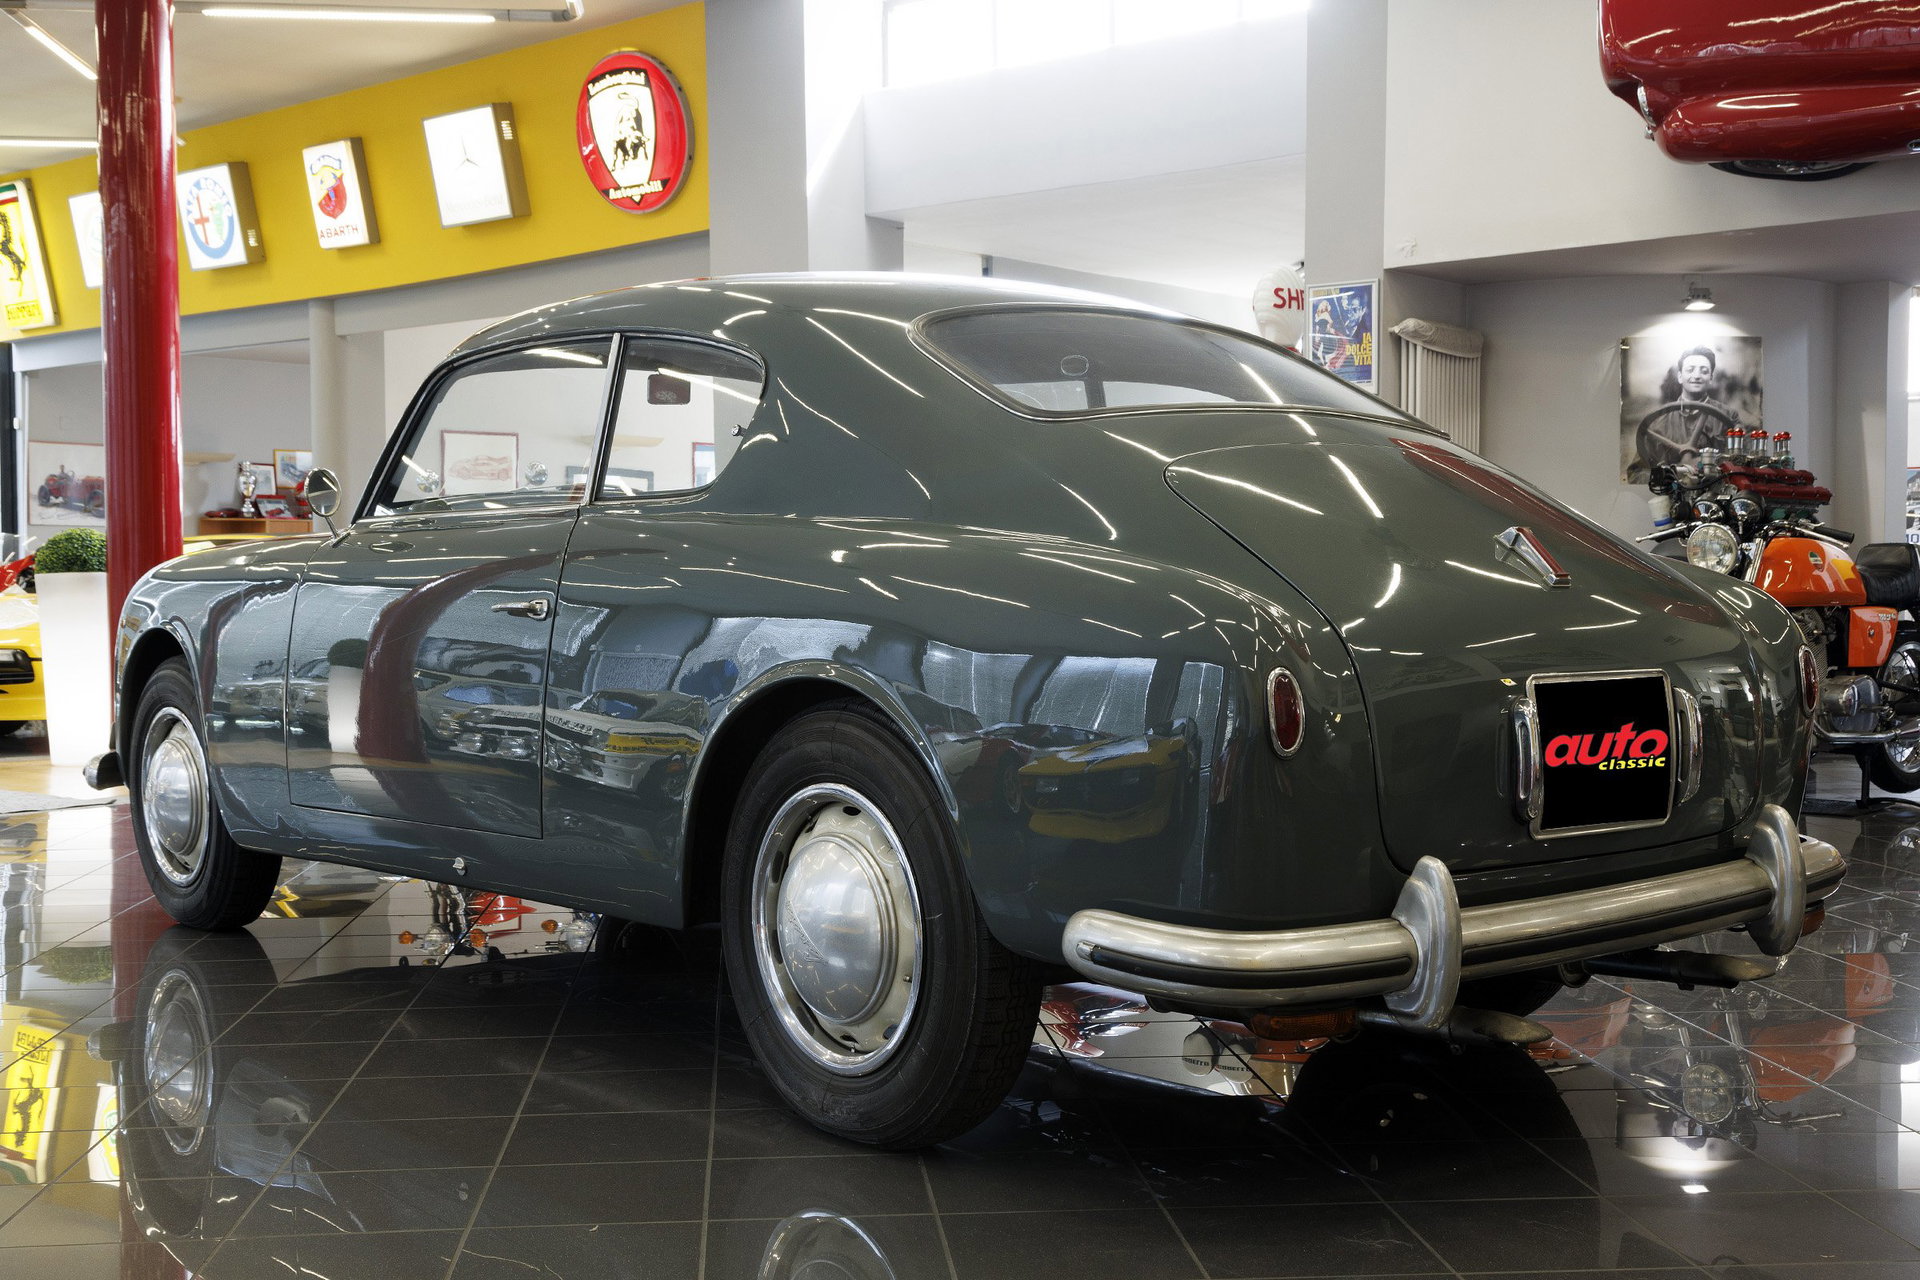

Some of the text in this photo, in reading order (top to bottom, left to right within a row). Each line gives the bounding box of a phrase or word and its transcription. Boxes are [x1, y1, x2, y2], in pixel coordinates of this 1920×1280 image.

[320, 224, 359, 239] ABARTH
[1346, 343, 1371, 355] DOLCE
[1354, 355, 1371, 365] VITA
